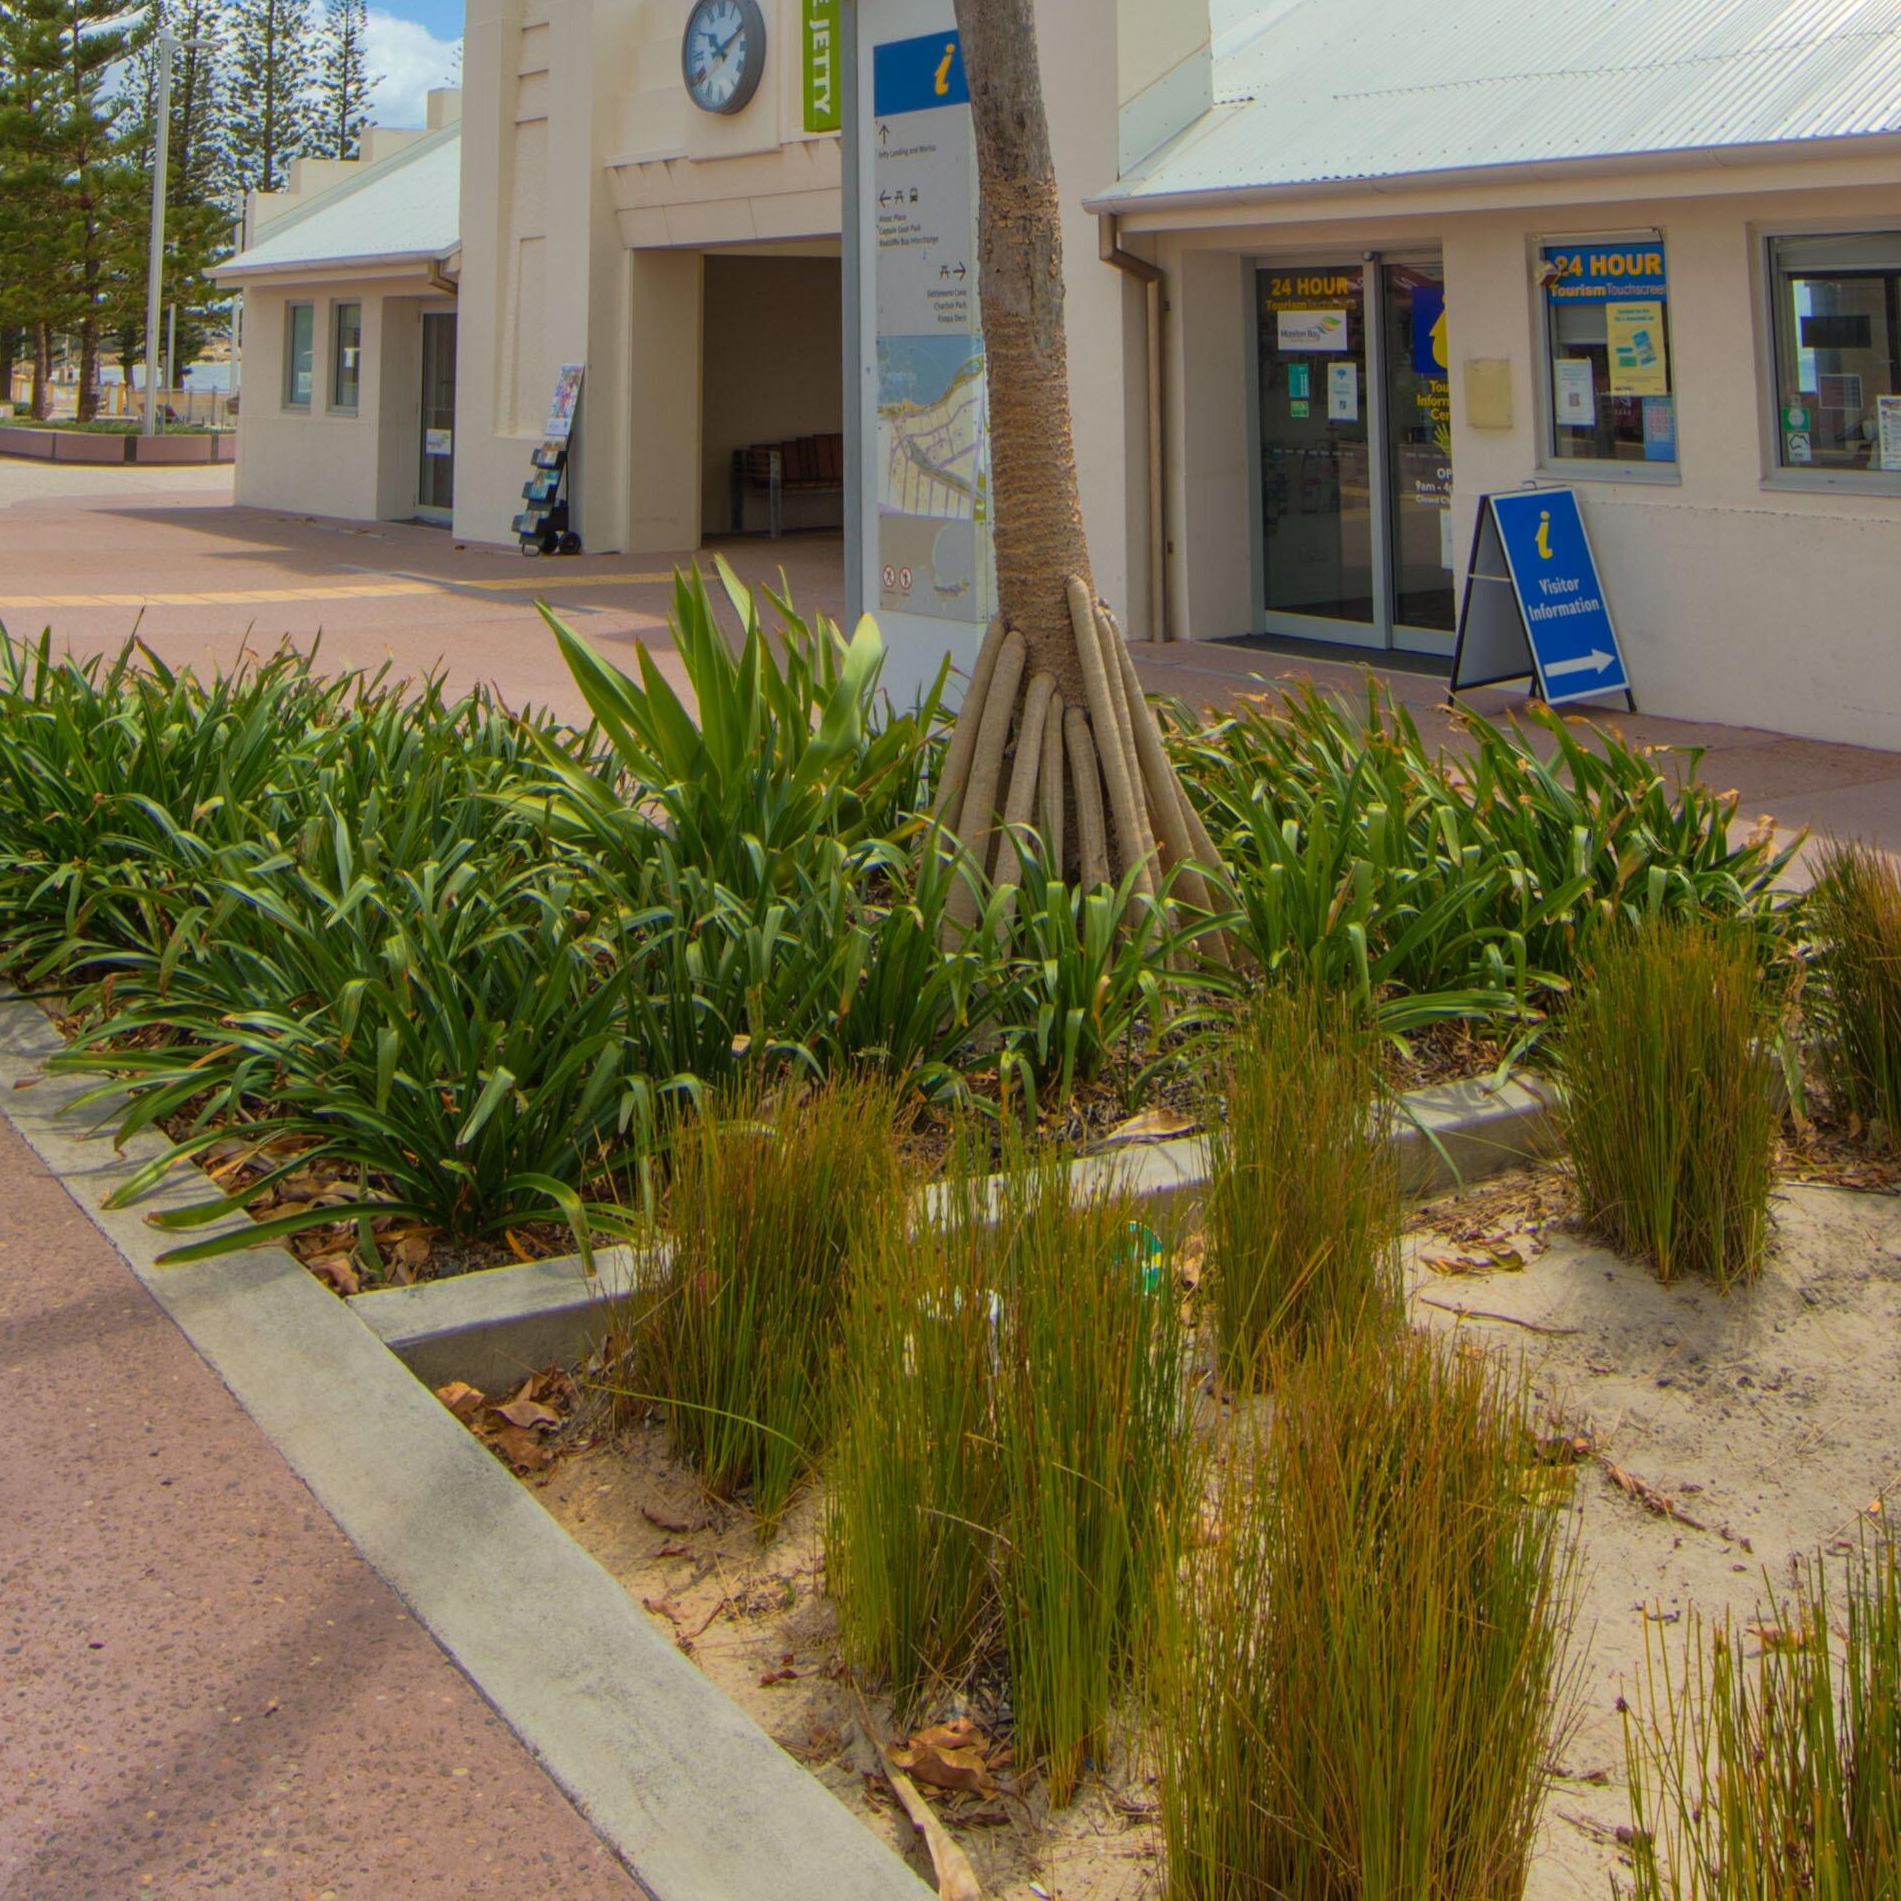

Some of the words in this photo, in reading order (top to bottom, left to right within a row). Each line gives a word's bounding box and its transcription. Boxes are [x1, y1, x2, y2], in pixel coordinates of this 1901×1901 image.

[809, 19, 830, 115] JETTY
[1554, 255, 1583, 276] 24
[1590, 253, 1663, 276] HOUR
[1271, 277, 1292, 296] 24
[1296, 276, 1348, 296] HOUR
[1308, 328, 1320, 341] Bay
[1415, 480, 1436, 492] 9am
[1539, 577, 1579, 596] Visitor
[1528, 597, 1599, 622] Information
